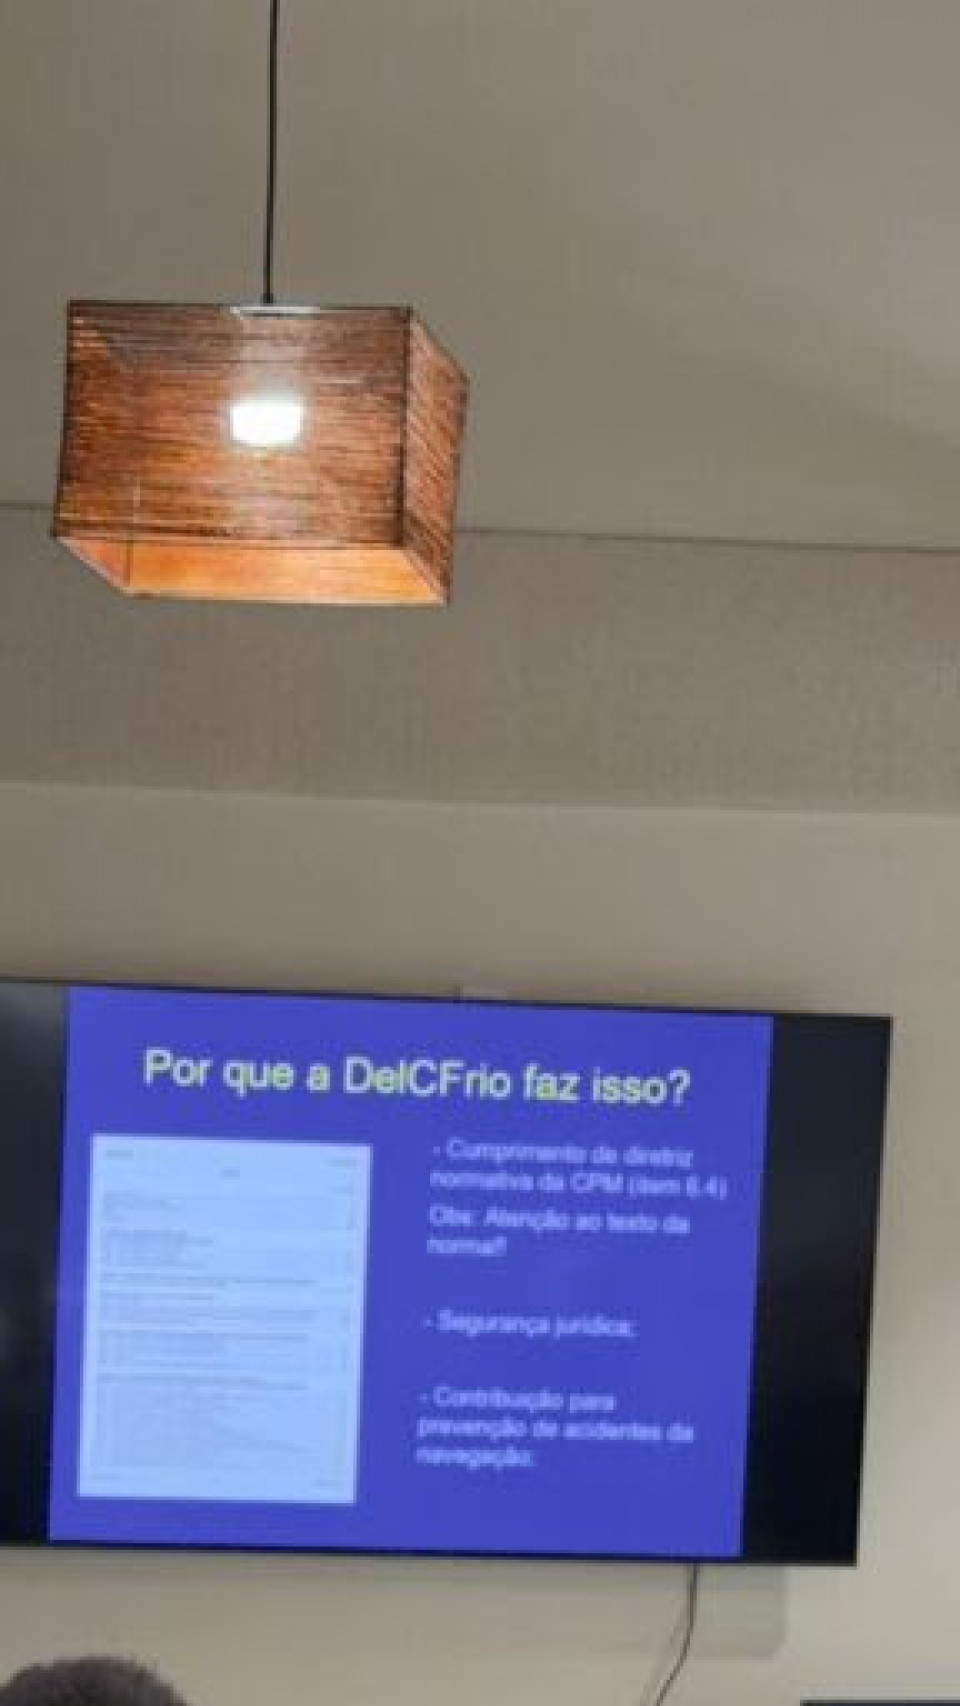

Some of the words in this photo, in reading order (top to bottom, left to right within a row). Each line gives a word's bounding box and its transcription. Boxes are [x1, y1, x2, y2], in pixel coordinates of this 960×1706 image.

[143, 1047, 213, 1087] Por
[223, 1059, 295, 1098] que
[306, 1062, 331, 1094] a
[343, 1055, 512, 1097] DelCFrio
[523, 1062, 581, 1102] faz
[592, 1067, 691, 1106] isso?
